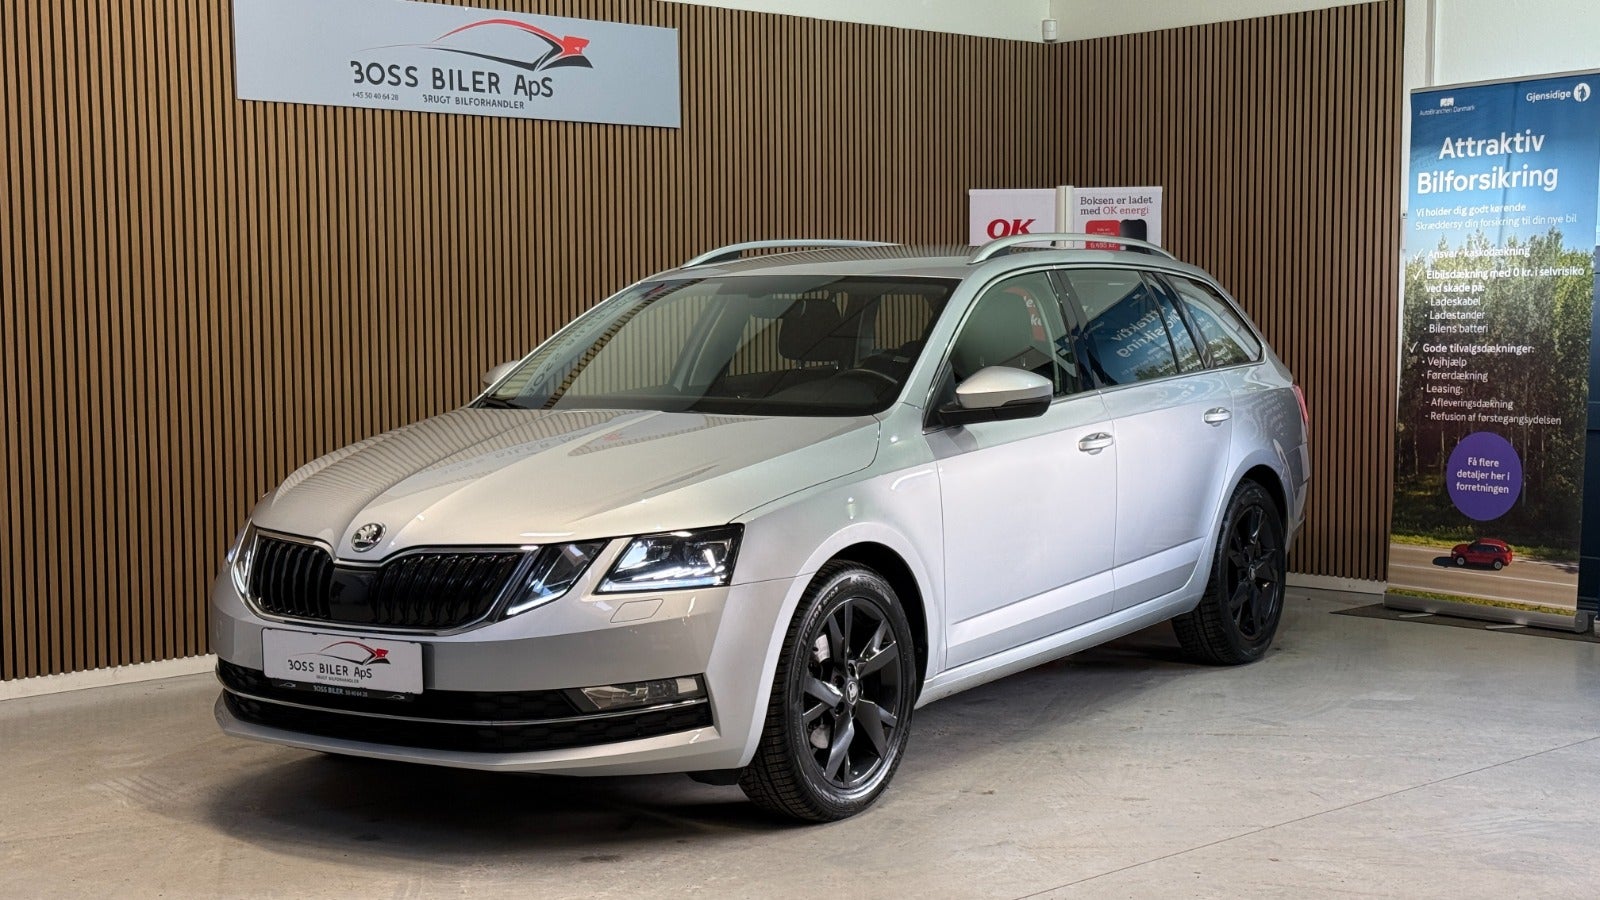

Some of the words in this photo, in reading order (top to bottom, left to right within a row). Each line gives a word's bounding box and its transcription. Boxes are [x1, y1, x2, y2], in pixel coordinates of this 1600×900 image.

[432, 67, 502, 95] BILER
[514, 74, 554, 101] ApS
[1526, 89, 1572, 104] Gjensidige
[455, 96, 525, 110] BILFORHANDLER
[1438, 129, 1546, 160] Attraktiv
[1417, 164, 1558, 194] Bilforsikring
[1080, 196, 1114, 205] Boksen
[1128, 196, 1153, 204] ladet
[1080, 207, 1100, 215] med
[1120, 206, 1149, 216] energi
[1416, 208, 1424, 217] Vi
[1425, 207, 1451, 216] holder
[1454, 206, 1468, 217] dig
[1469, 206, 1489, 217] godt
[1490, 203, 1526, 213] kørende
[1416, 220, 1462, 231] Skræddersy
[1465, 219, 1478, 228] din
[1480, 218, 1520, 228] forsikring
[1522, 216, 1530, 225] til
[1532, 216, 1546, 224] din
[1549, 216, 1563, 226] nye
[1566, 214, 1577, 223] bil
[987, 218, 1036, 240] OK
[1464, 247, 1530, 258] kaskodækning
[1426, 269, 1488, 280] Elbilsdækning
[1490, 268, 1510, 278] med
[1513, 268, 1520, 277] 0
[1522, 267, 1533, 277] kr.
[1539, 266, 1584, 276] selvrisiko
[1426, 284, 1441, 293] ved
[1443, 283, 1470, 292] skade
[1472, 283, 1485, 294] på:
[1430, 297, 1481, 307] Ladeskabel
[1430, 311, 1485, 320] Ladestander
[1429, 324, 1457, 334] Bilens
[1459, 324, 1489, 333] batteri
[1423, 344, 1447, 353] Gode
[1450, 344, 1535, 356] tilvalgsdækninger:
[1428, 357, 1467, 368] Vejhjælp
[1427, 371, 1488, 382] Førerdækning
[1426, 384, 1464, 396] Leasing:
[1431, 398, 1513, 410] Afleveringsdækning
[1430, 412, 1466, 422] Refusion
[1468, 413, 1476, 422] af
[1478, 414, 1561, 426] førstegangsydelsen
[1468, 457, 1477, 466] Få
[1479, 457, 1499, 467] flere
[1456, 470, 1489, 481] detaljer
[1490, 471, 1505, 480] her
[1456, 482, 1509, 494] forretningen
[319, 663, 349, 676] BILER
[354, 667, 372, 679] ApS
